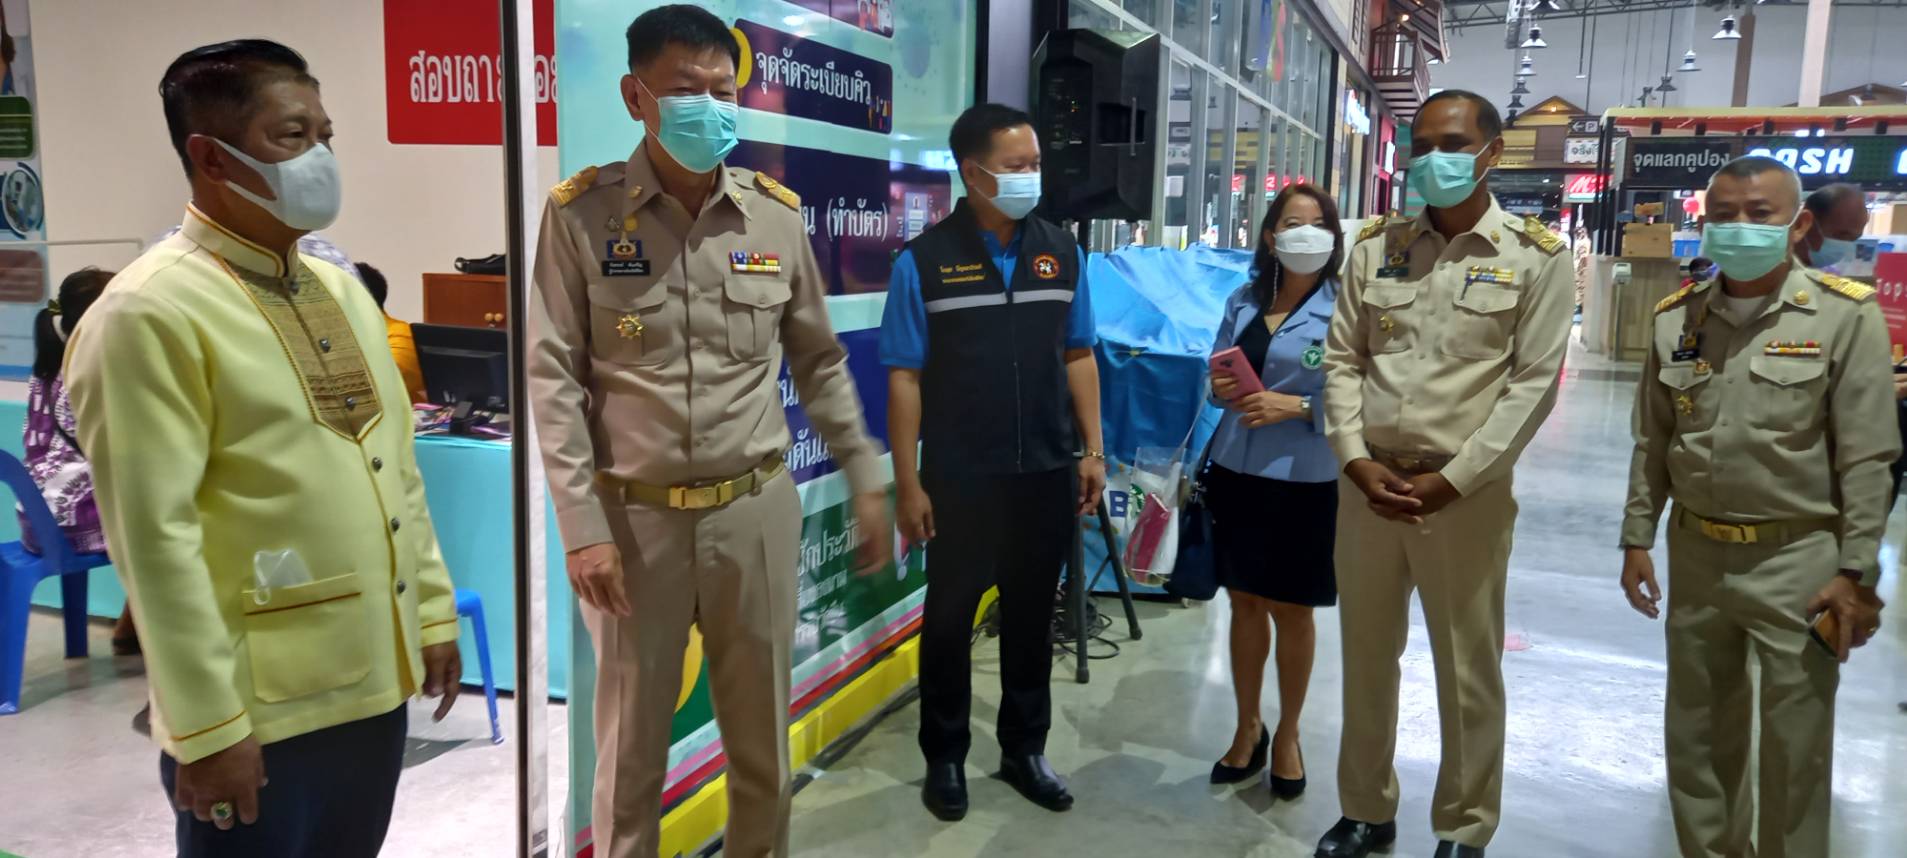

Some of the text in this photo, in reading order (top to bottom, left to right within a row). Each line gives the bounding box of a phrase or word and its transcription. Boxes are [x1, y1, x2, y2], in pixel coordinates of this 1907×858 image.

[756, 47, 872, 105] จุดจัดระเบียบคิว
[1633, 149, 1730, 172] จุดแลกคูปอง
[826, 197, 888, 242] (ทำบัตร)
